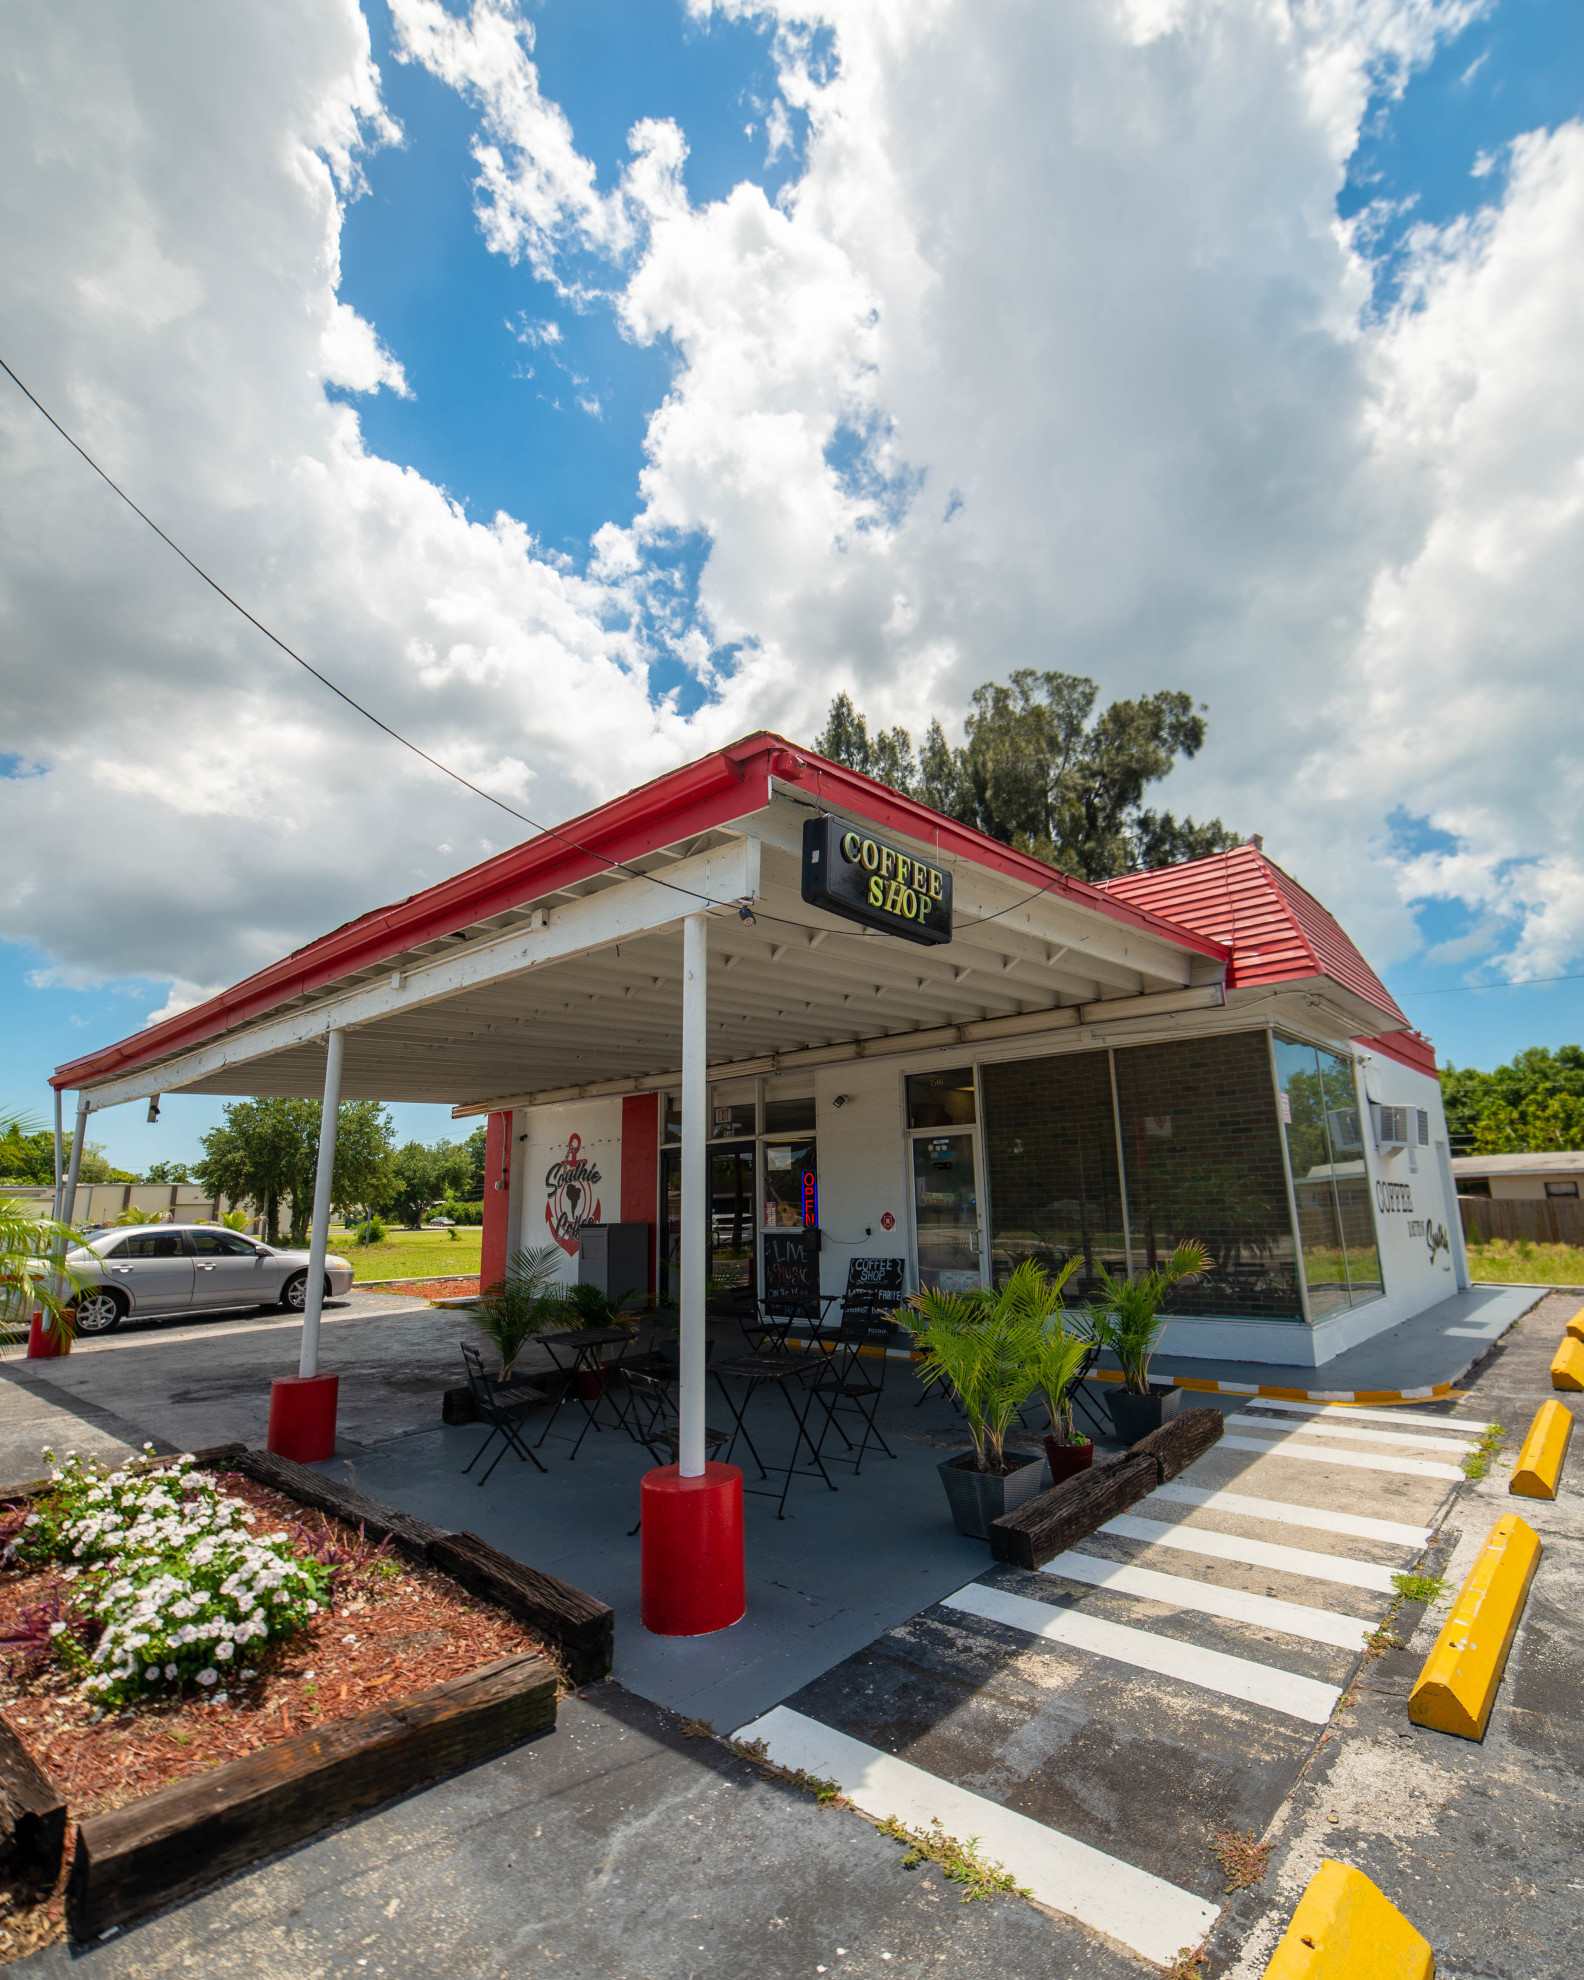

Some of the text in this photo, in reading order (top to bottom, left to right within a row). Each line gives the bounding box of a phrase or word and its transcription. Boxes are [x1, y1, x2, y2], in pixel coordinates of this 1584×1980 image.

[842, 832, 943, 901] COFFEE
[868, 876, 932, 924] SHOP
[545, 1162, 602, 1199] Southie
[1376, 1180, 1414, 1214] COFFEE
[804, 1172, 815, 1227] OPEN
[773, 1240, 808, 1263] LIVE
[855, 1259, 893, 1271] COFFEE
[861, 1270, 885, 1281] SHOP
